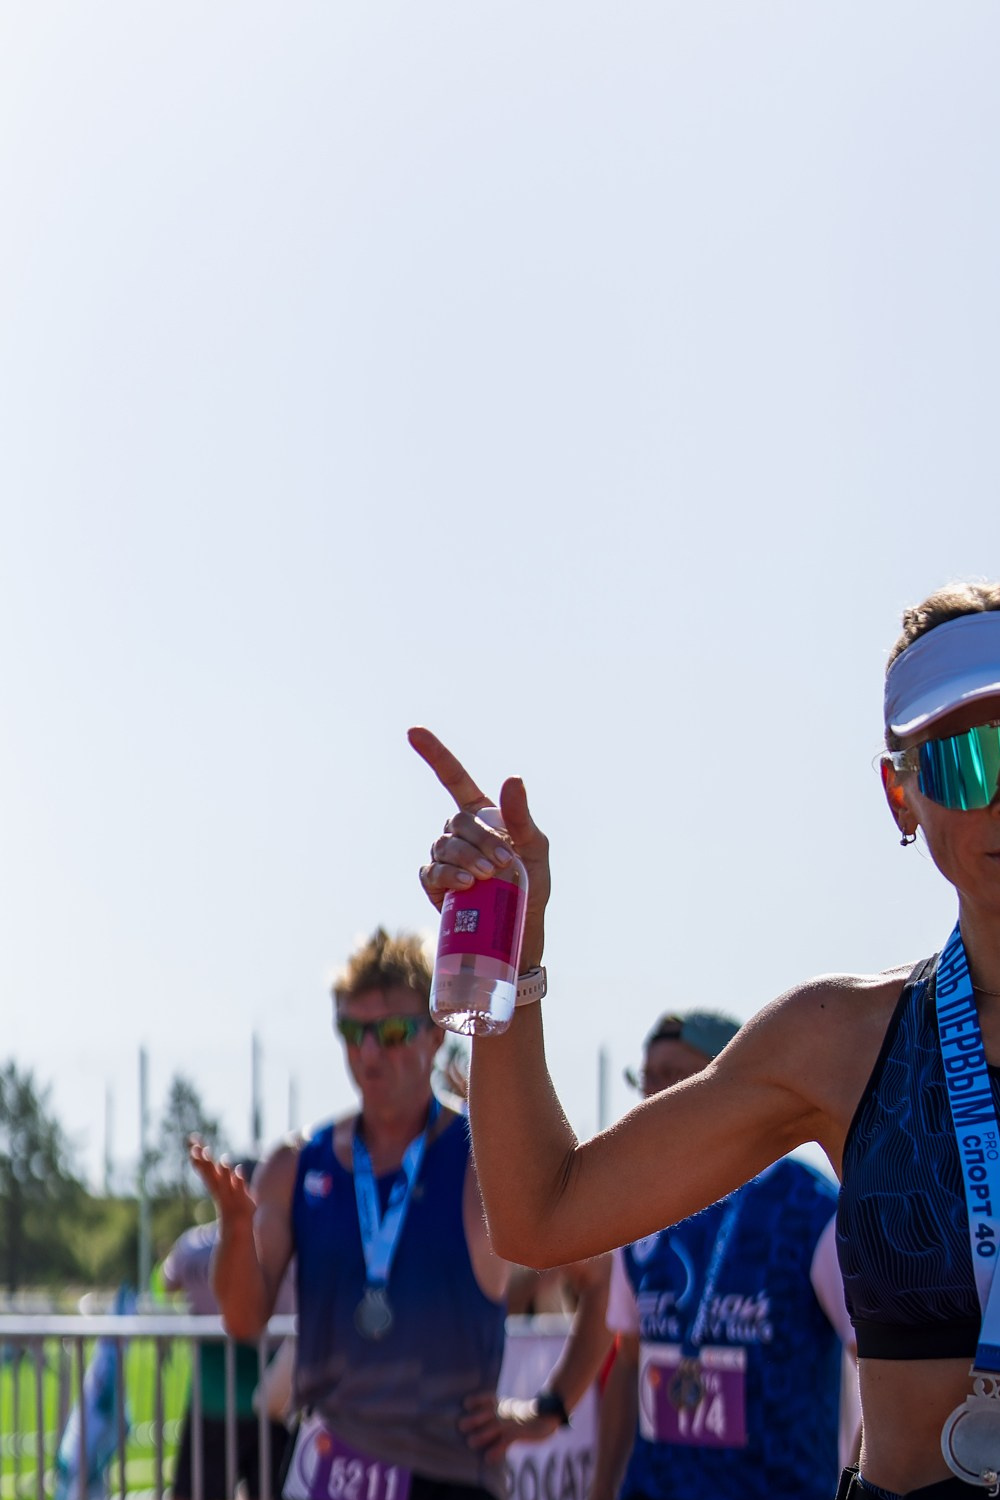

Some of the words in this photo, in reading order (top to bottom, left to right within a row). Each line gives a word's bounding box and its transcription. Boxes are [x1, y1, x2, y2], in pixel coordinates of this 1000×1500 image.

[938, 994, 997, 1127] ПЕРВЫМ
[983, 1131, 999, 1161] PRO
[962, 1135, 992, 1217] СПОРТ
[975, 1223, 996, 1257] 40
